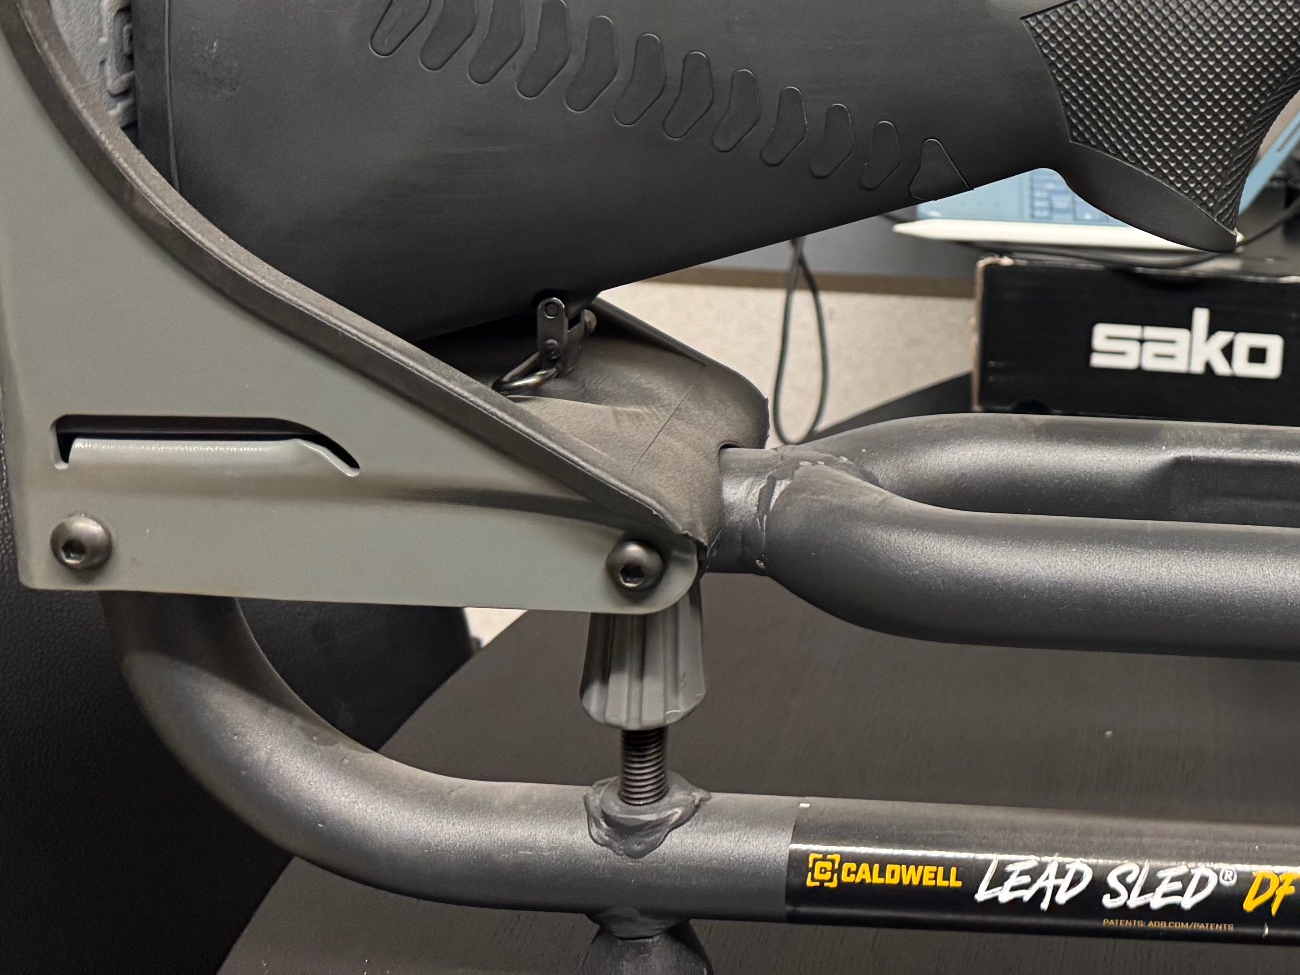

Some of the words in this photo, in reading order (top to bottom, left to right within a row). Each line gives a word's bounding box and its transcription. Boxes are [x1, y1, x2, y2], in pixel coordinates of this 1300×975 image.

[1089, 307, 1285, 380] sako
[841, 862, 963, 888] CALDWELL
[974, 854, 1093, 911] LEAD
